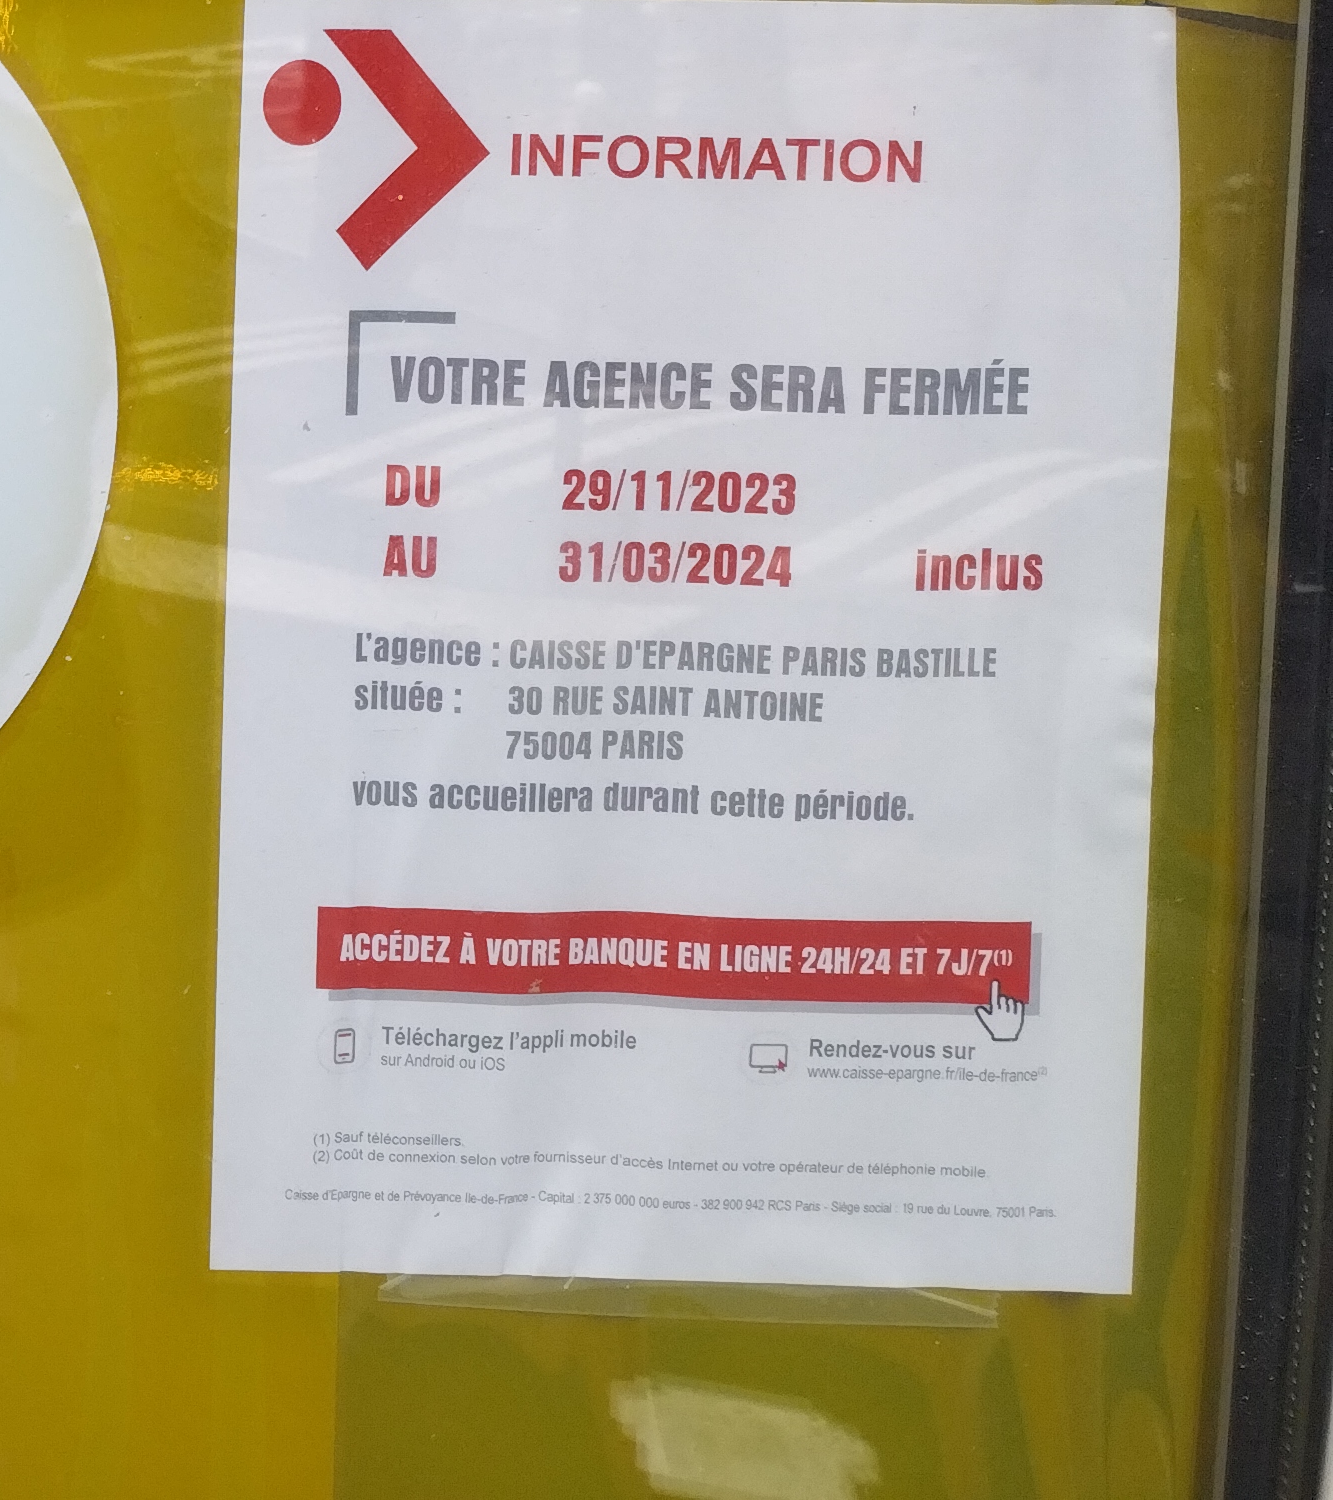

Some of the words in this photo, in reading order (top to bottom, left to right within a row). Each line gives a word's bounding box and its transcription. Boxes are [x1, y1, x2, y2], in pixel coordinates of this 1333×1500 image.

[510, 133, 923, 183] INFORMATION
[390, 355, 527, 407] VOTRE
[542, 360, 713, 410] AGENCE
[729, 363, 846, 415] SERA
[863, 358, 1030, 416] FERMÉE
[385, 464, 441, 508] DU
[561, 468, 797, 516] 29/11/2023
[382, 534, 438, 579] AU
[558, 540, 792, 588] 31/03/2024
[915, 547, 1043, 592] inclus
[355, 632, 482, 667] L'agence
[509, 639, 606, 671] CAISSE
[615, 639, 772, 675] D'EPARGNE
[781, 645, 867, 678] PARIS
[876, 647, 997, 679] BASTILLE
[354, 680, 443, 713] située
[508, 685, 543, 716] 30
[552, 685, 604, 716] RUE
[612, 685, 694, 717] SAINT
[703, 687, 824, 723] ANTOINE
[505, 730, 592, 761] 75004
[601, 729, 684, 761] PARIS
[352, 780, 418, 808] vous
[428, 782, 593, 813] accueillera
[603, 781, 700, 815] durant
[710, 787, 785, 819] cette
[794, 788, 914, 822] période.
[339, 929, 451, 964] ACCÉDEZ
[459, 931, 477, 965] À
[485, 937, 561, 967] VOTRE
[568, 937, 668, 968] BANQUE
[677, 941, 711, 971] EN
[719, 943, 793, 973] LIGNE
[798, 946, 892, 975] 24H/24
[899, 947, 928, 975] ET
[381, 1025, 504, 1053] Téléchargez
[509, 1029, 565, 1054] l'appli
[569, 1029, 637, 1050] mobile
[809, 1038, 936, 1059] Rendez-vous
[942, 1044, 976, 1061] sur
[380, 1055, 402, 1067] sur
[403, 1053, 456, 1069] Android
[458, 1058, 477, 1070] ou
[480, 1056, 506, 1072] iOS
[313, 1132, 331, 1148] (1)
[334, 1130, 365, 1144] Sauf
[312, 1149, 331, 1165] (2)
[333, 1147, 364, 1162] Coût
[367, 1148, 385, 1162] de
[388, 1151, 456, 1164] connexion
[459, 1153, 497, 1167] selon
[500, 1153, 531, 1166] votre
[533, 1150, 607, 1165] fournisseur
[610, 1153, 664, 1170] d'accès
[667, 1158, 719, 1172] Internet
[721, 1161, 739, 1172] ou
[742, 1160, 776, 1173] votre
[778, 1161, 844, 1176] opérateur
[846, 1162, 864, 1175] de
[867, 1162, 936, 1177] téléphonie
[284, 1188, 320, 1201] Caisse
[321, 1188, 372, 1203] d'Epargne
[374, 1190, 385, 1202] et
[387, 1190, 401, 1202] de
[403, 1190, 462, 1205] Prévoyance
[537, 1189, 575, 1206] Capital
[583, 1192, 591, 1205] 2
[592, 1192, 612, 1205] 375
[614, 1193, 636, 1207] 000
[638, 1195, 660, 1209] 000
[662, 1200, 691, 1210] euros
[700, 1198, 721, 1211] 382
[722, 1198, 744, 1211] 900
[745, 1198, 765, 1211] 942
[767, 1199, 792, 1212] RCS
[795, 1200, 821, 1212] Paris
[830, 1200, 861, 1216] Siège
[862, 1202, 892, 1214] social
[902, 1202, 914, 1214] 19
[916, 1205, 935, 1215] rue
[936, 1203, 951, 1216] du
[995, 1206, 1026, 1219] 75001
